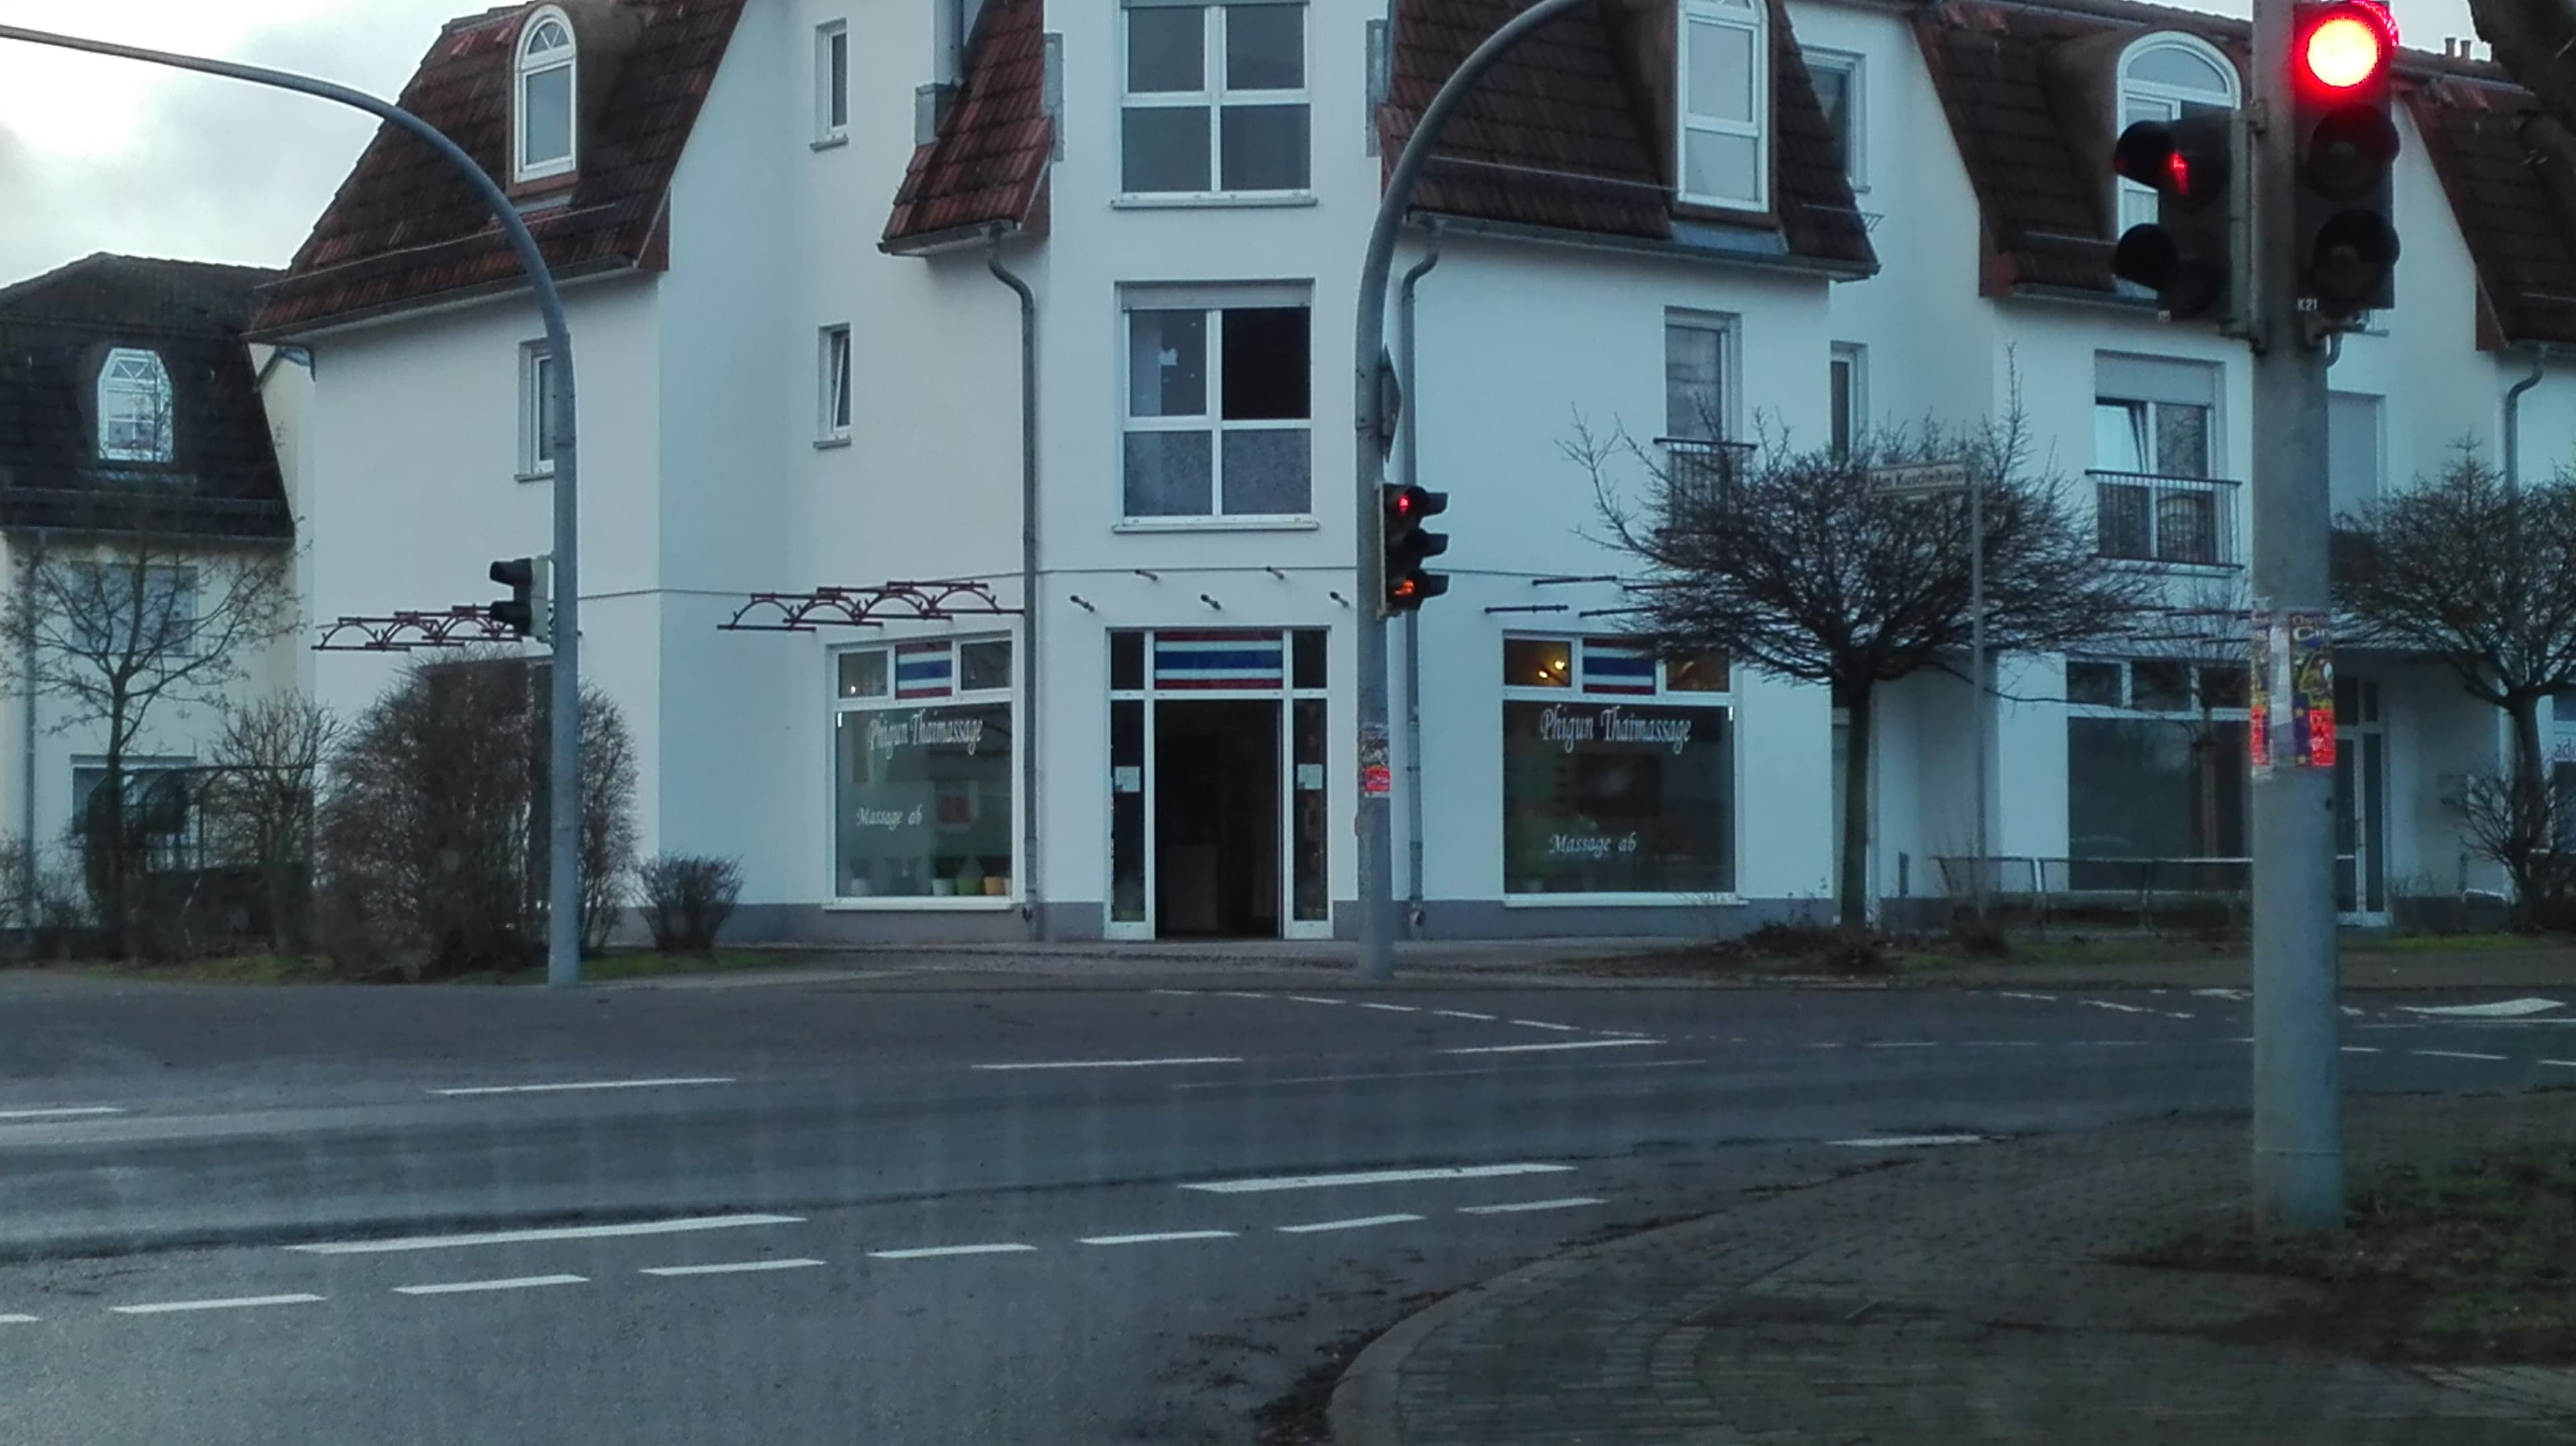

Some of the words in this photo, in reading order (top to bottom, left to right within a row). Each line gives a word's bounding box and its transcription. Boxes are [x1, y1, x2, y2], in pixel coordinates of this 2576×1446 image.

[910, 708, 983, 755] Thaimassage
[1600, 706, 1691, 755] Thaimassage
[856, 807, 903, 832] Massage
[908, 804, 923, 826] ab
[1548, 834, 1611, 858] Massage
